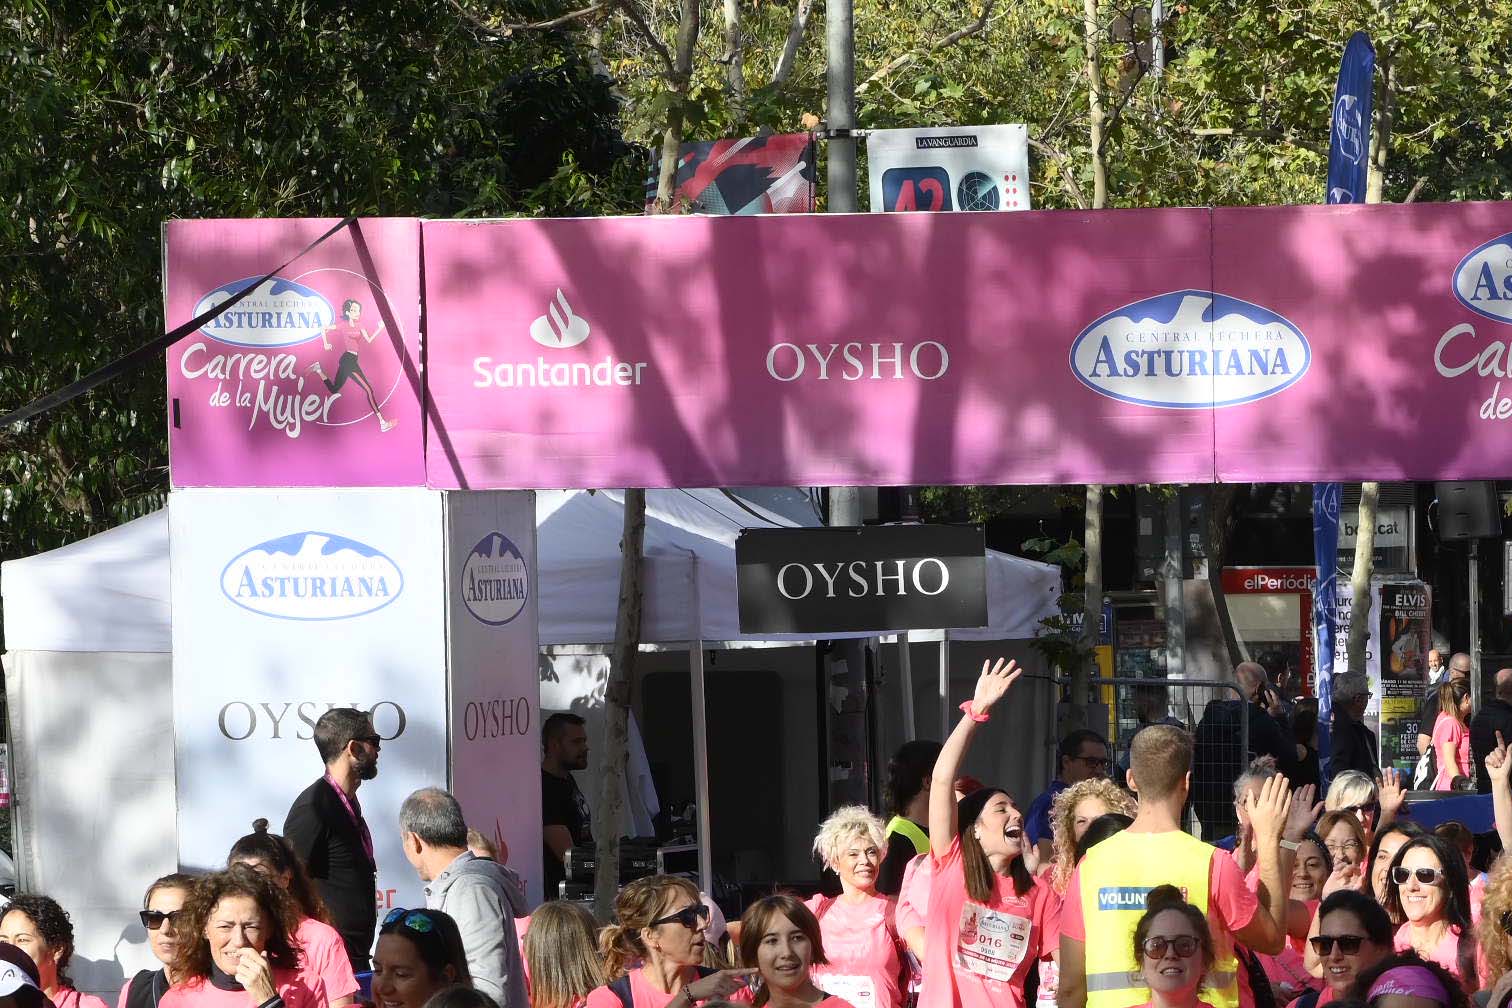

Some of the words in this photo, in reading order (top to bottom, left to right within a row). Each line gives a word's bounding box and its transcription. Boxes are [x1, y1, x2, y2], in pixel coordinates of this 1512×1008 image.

[930, 136, 977, 147] VANGUARDIA
[204, 302, 324, 330] ASTURIANA
[1126, 329, 1201, 343] CENTRAL
[180, 341, 297, 380] Carrera
[473, 356, 649, 388] Santander
[766, 340, 950, 384] OYSHO
[1089, 334, 1292, 379] ASTURIANA
[209, 381, 231, 407] de
[235, 380, 251, 407] la
[248, 376, 342, 438] Mujer
[235, 564, 391, 599] ASTURIANA
[466, 564, 525, 603] ASTURIANA
[776, 556, 950, 600] OYSHO
[1395, 594, 1426, 607] ELVIS
[217, 700, 408, 741] OYSO
[464, 697, 530, 742] OYSHO
[1406, 723, 1418, 734] 30
[979, 934, 1003, 948] 016
